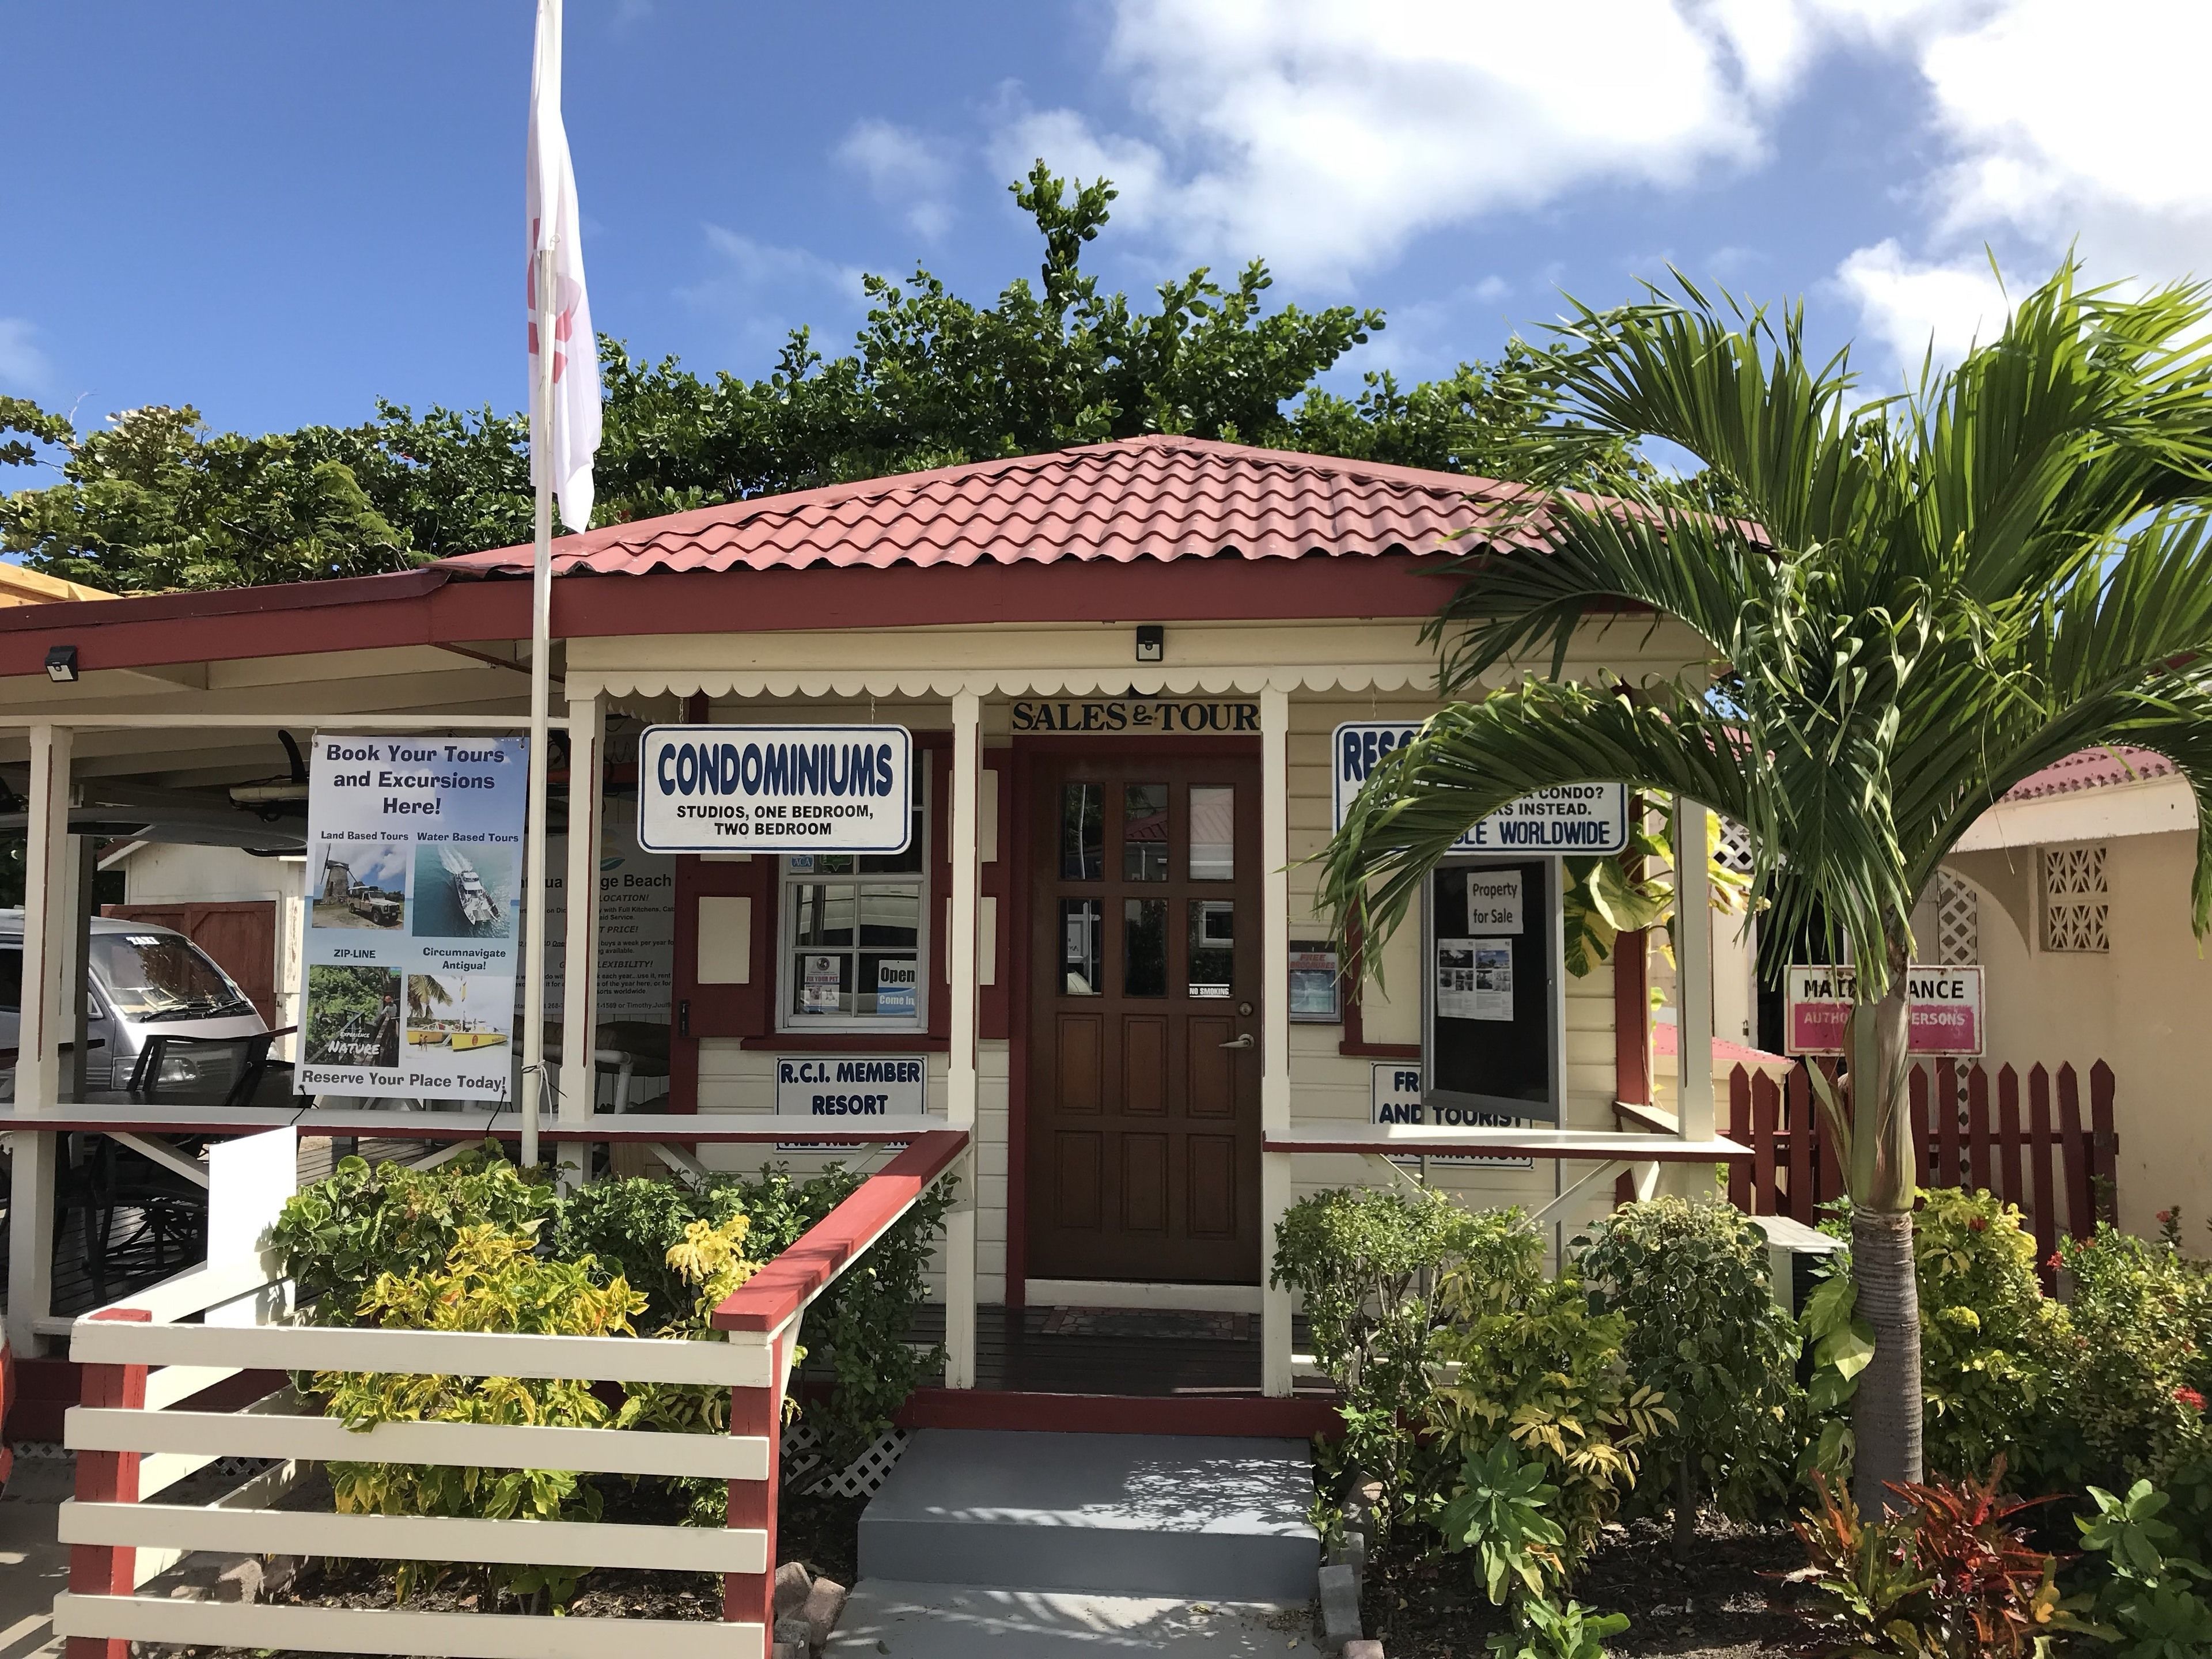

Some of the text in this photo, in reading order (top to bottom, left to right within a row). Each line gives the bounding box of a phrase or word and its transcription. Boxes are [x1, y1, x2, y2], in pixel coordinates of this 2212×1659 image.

[1012, 702, 1127, 731] SALES
[1132, 704, 1153, 726] &
[327, 744, 505, 763] Book Your Tours
[658, 743, 893, 797] CONDOMINIUMS
[334, 770, 495, 789] and Excursions
[1538, 786, 1604, 800] CONDO?
[383, 797, 441, 815] Here!
[677, 805, 874, 820] STUDIOS, ONE BEDROOM,
[1518, 803, 1592, 816] INSTEAD.
[321, 831, 409, 840] Land Based Tours
[714, 823, 831, 835] TWO BEDROOM
[1499, 821, 1610, 844] WORLDWIDE
[416, 832, 518, 843] Water Based Tours
[624, 873, 672, 887] Beach
[1472, 883, 1518, 899] Property
[1474, 909, 1513, 923] for Sale
[334, 949, 376, 959] ZIP-LINE
[423, 947, 506, 960] Circumnavigate
[442, 960, 486, 971] Antigua!
[881, 967, 915, 983] Open
[880, 995, 916, 1005] Come In
[1911, 1012, 1965, 1027] ERSONS
[328, 1040, 381, 1055] NATURE
[781, 1062, 920, 1084] R.C.I. MEMBER
[302, 1070, 506, 1093] Reserve Your Place Today!
[812, 1095, 888, 1115] RESORT
